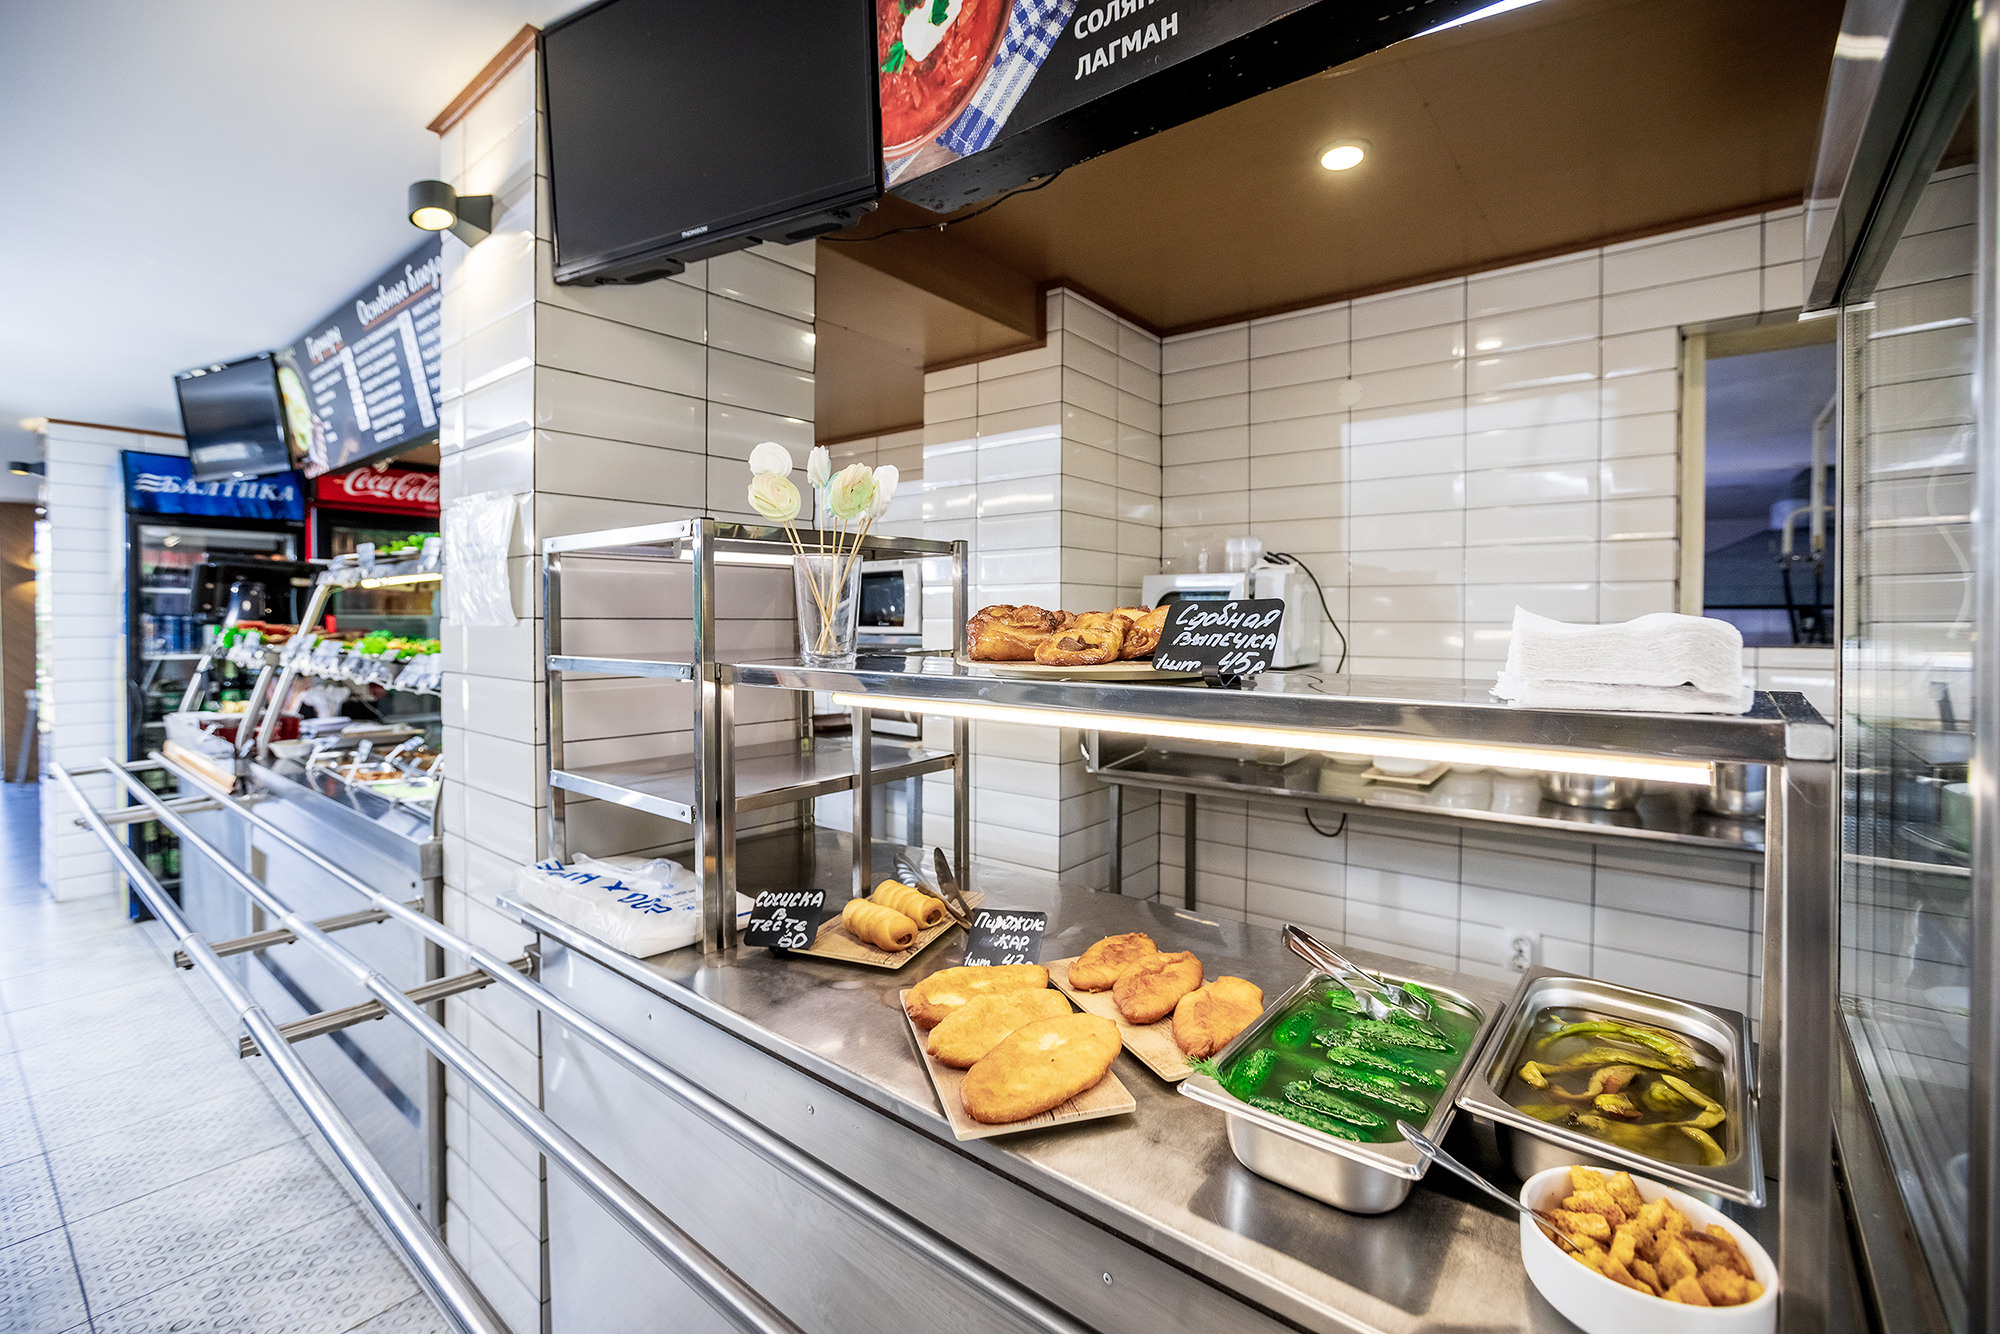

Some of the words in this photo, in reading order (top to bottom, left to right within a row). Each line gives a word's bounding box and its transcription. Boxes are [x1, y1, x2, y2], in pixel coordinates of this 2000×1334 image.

[1074, 0, 1155, 39] СОЛЯ
[1075, 12, 1178, 80] ЛАГМАН
[134, 472, 294, 501] БАЛТИКА
[1172, 631, 1277, 651] ВЫПЕЧКА
[778, 930, 808, 949] 60
